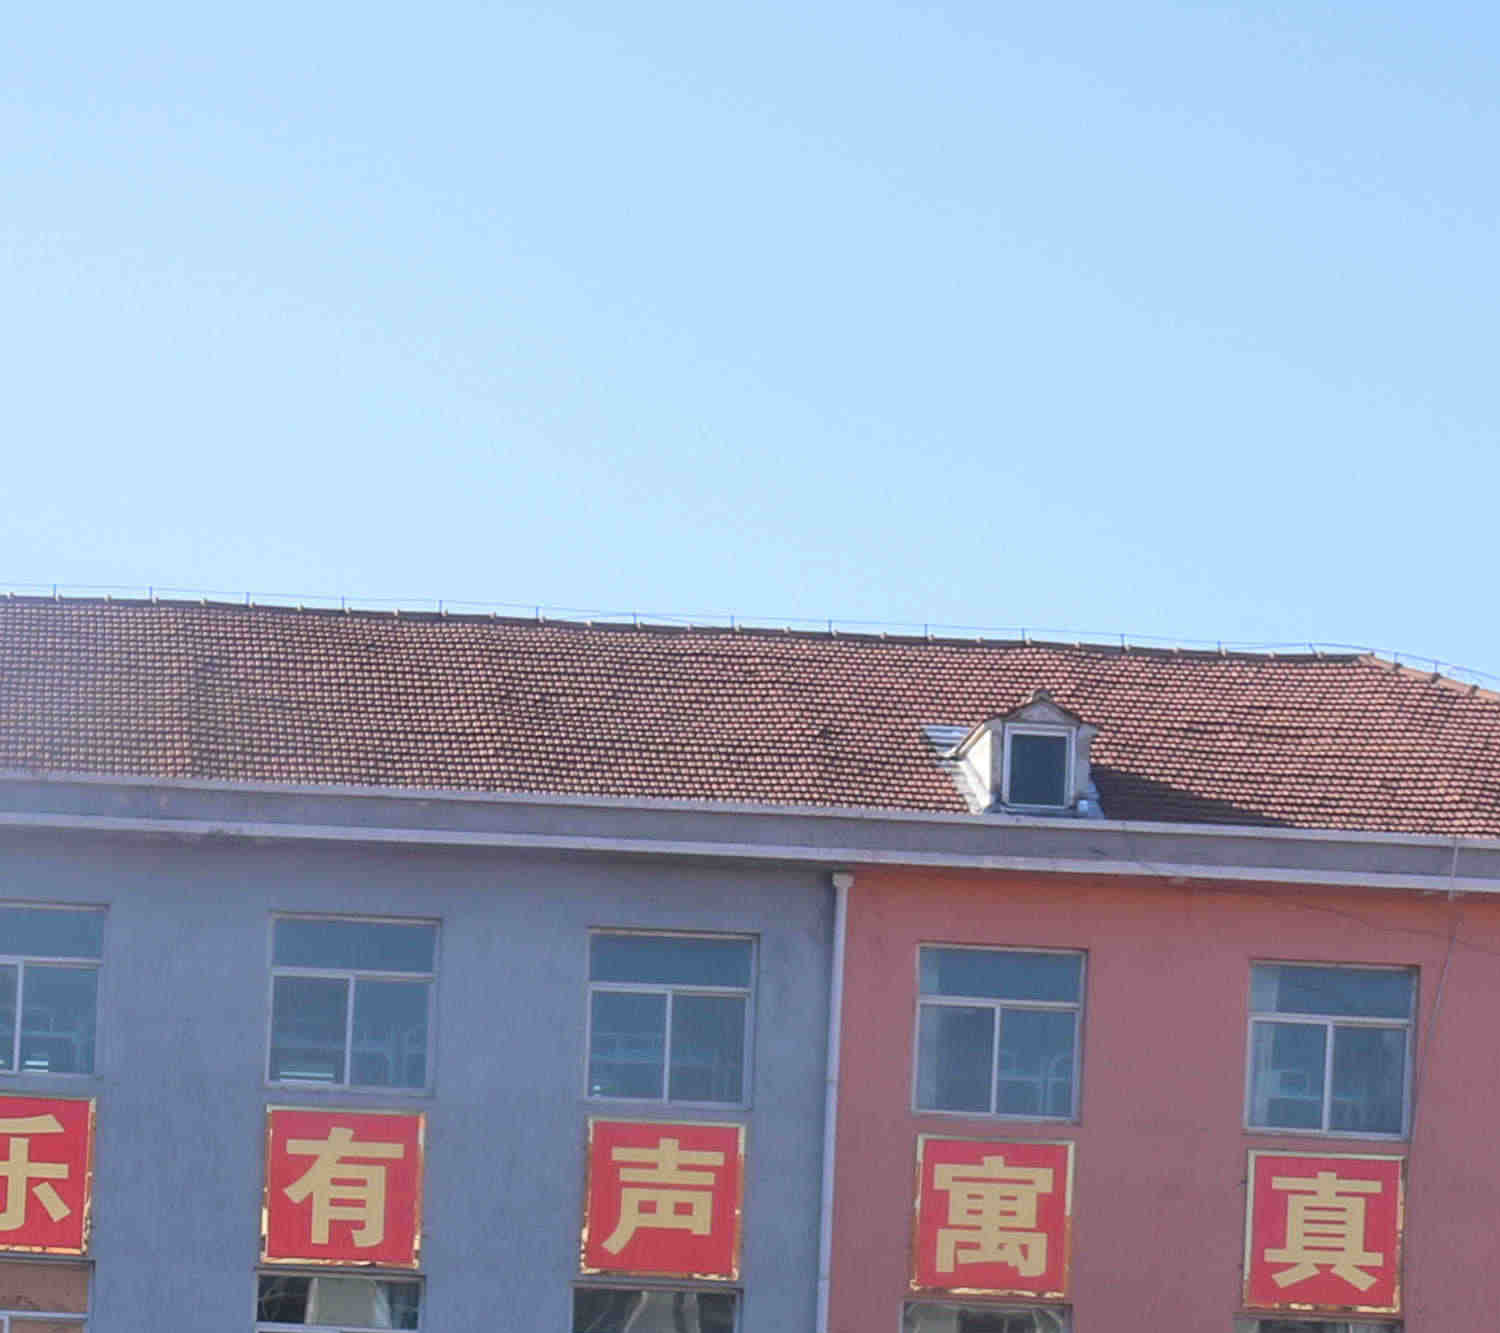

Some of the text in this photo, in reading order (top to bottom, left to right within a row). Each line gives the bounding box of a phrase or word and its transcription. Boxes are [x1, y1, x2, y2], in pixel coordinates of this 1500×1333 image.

[286, 1128, 403, 1247] 有
[604, 1138, 724, 1257] 声
[936, 1155, 1053, 1276] 寓
[1265, 1171, 1382, 1289] 真
